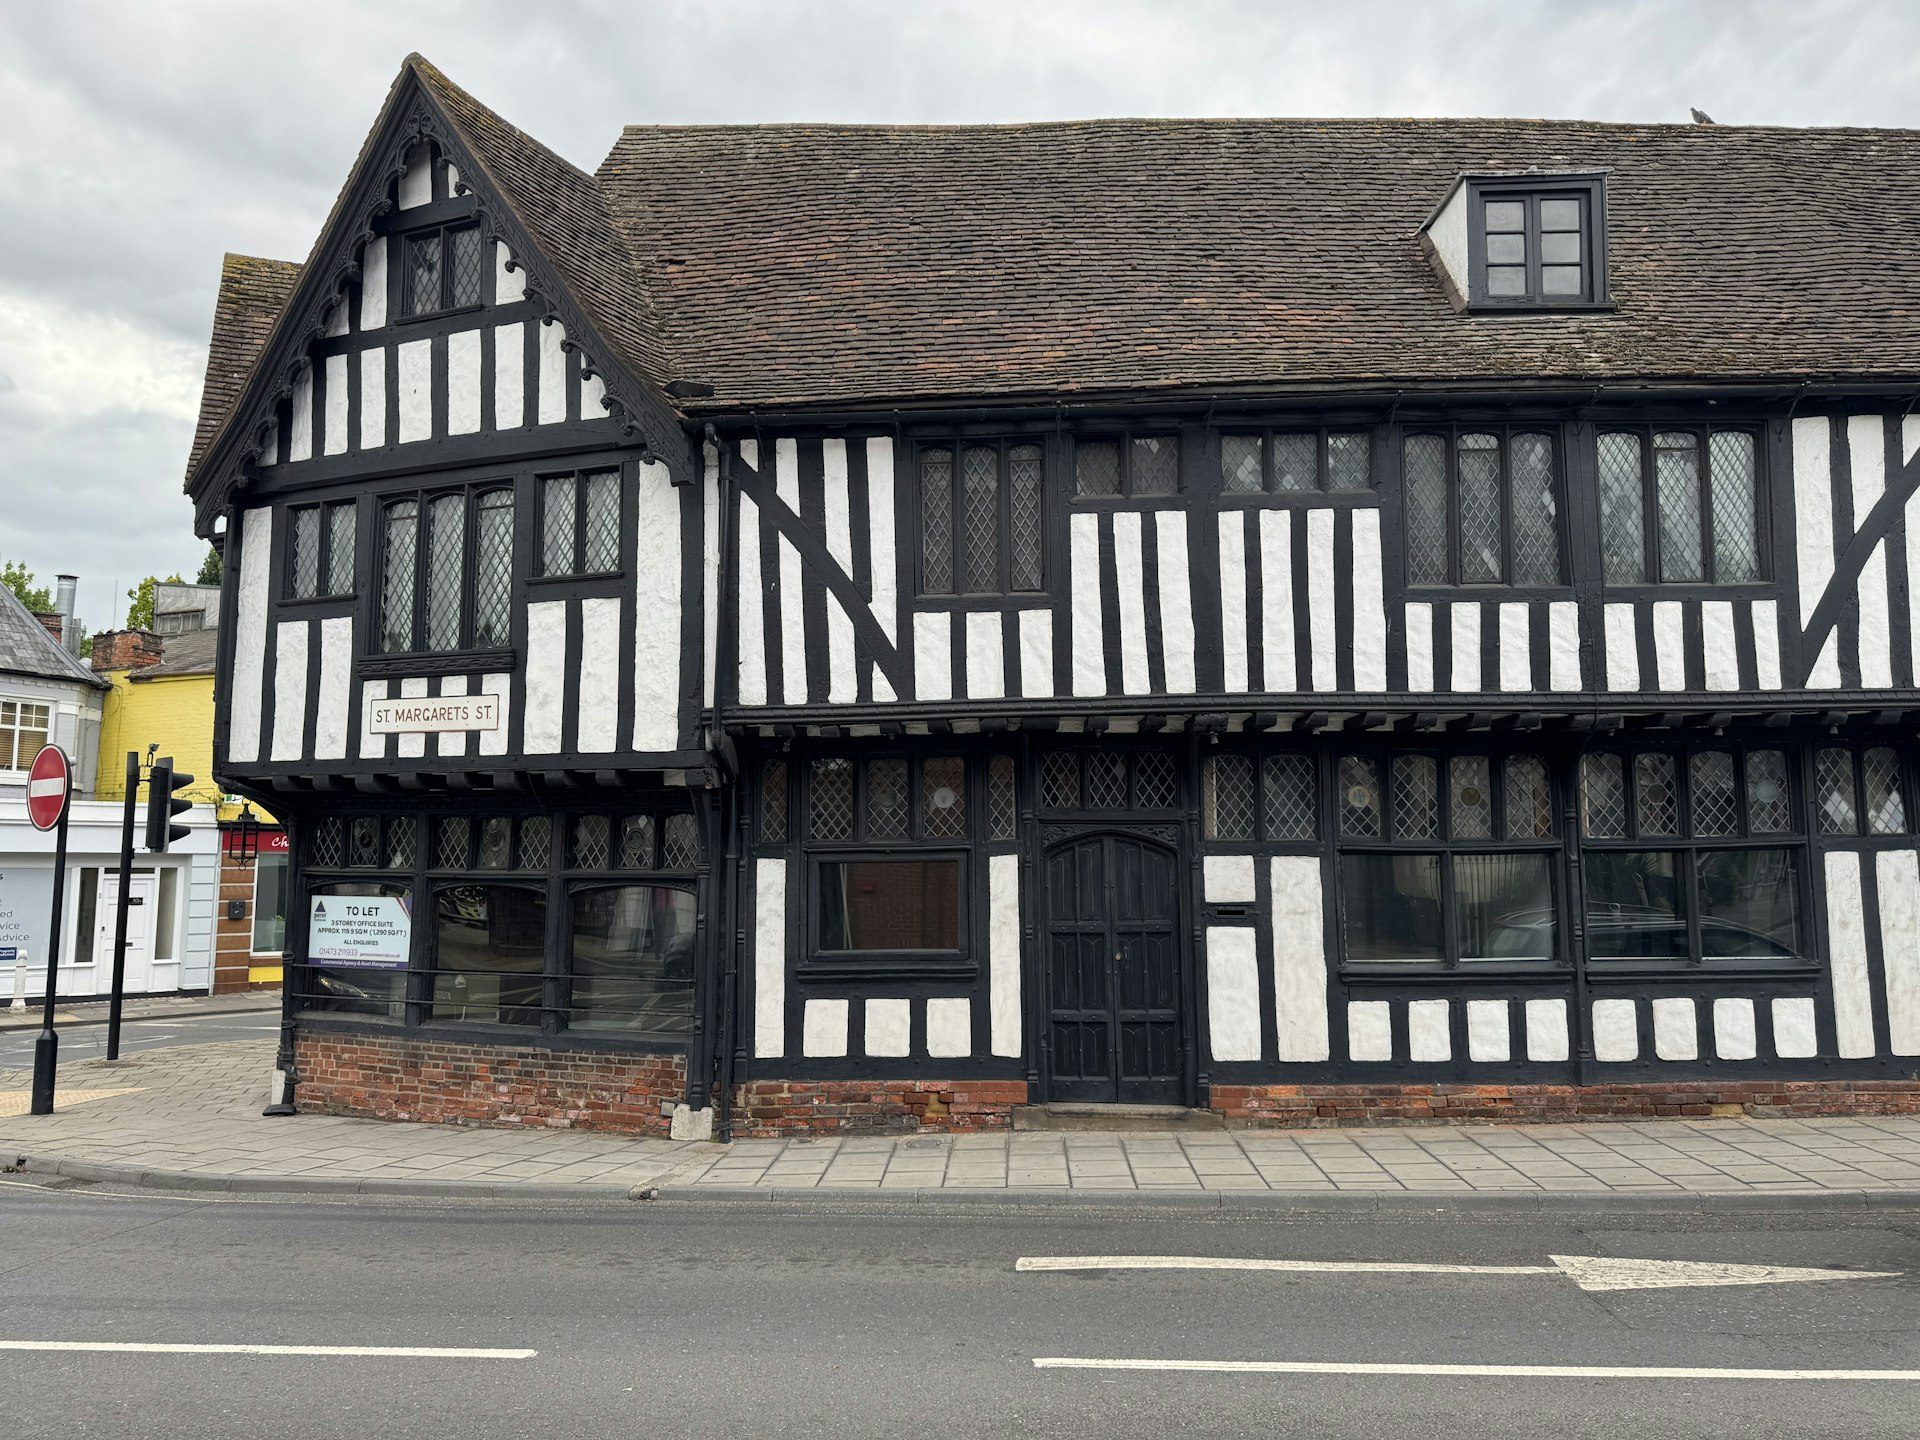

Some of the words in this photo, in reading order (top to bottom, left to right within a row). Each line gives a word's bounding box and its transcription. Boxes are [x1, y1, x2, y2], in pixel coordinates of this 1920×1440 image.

[376, 709, 390, 723] ST.
[395, 706, 469, 722] MARGARETS
[475, 705, 491, 720] ST.
[346, 907, 359, 916] TO
[362, 907, 380, 916] LET
[319, 948, 337, 956] 01473
[338, 948, 358, 957] 211933
